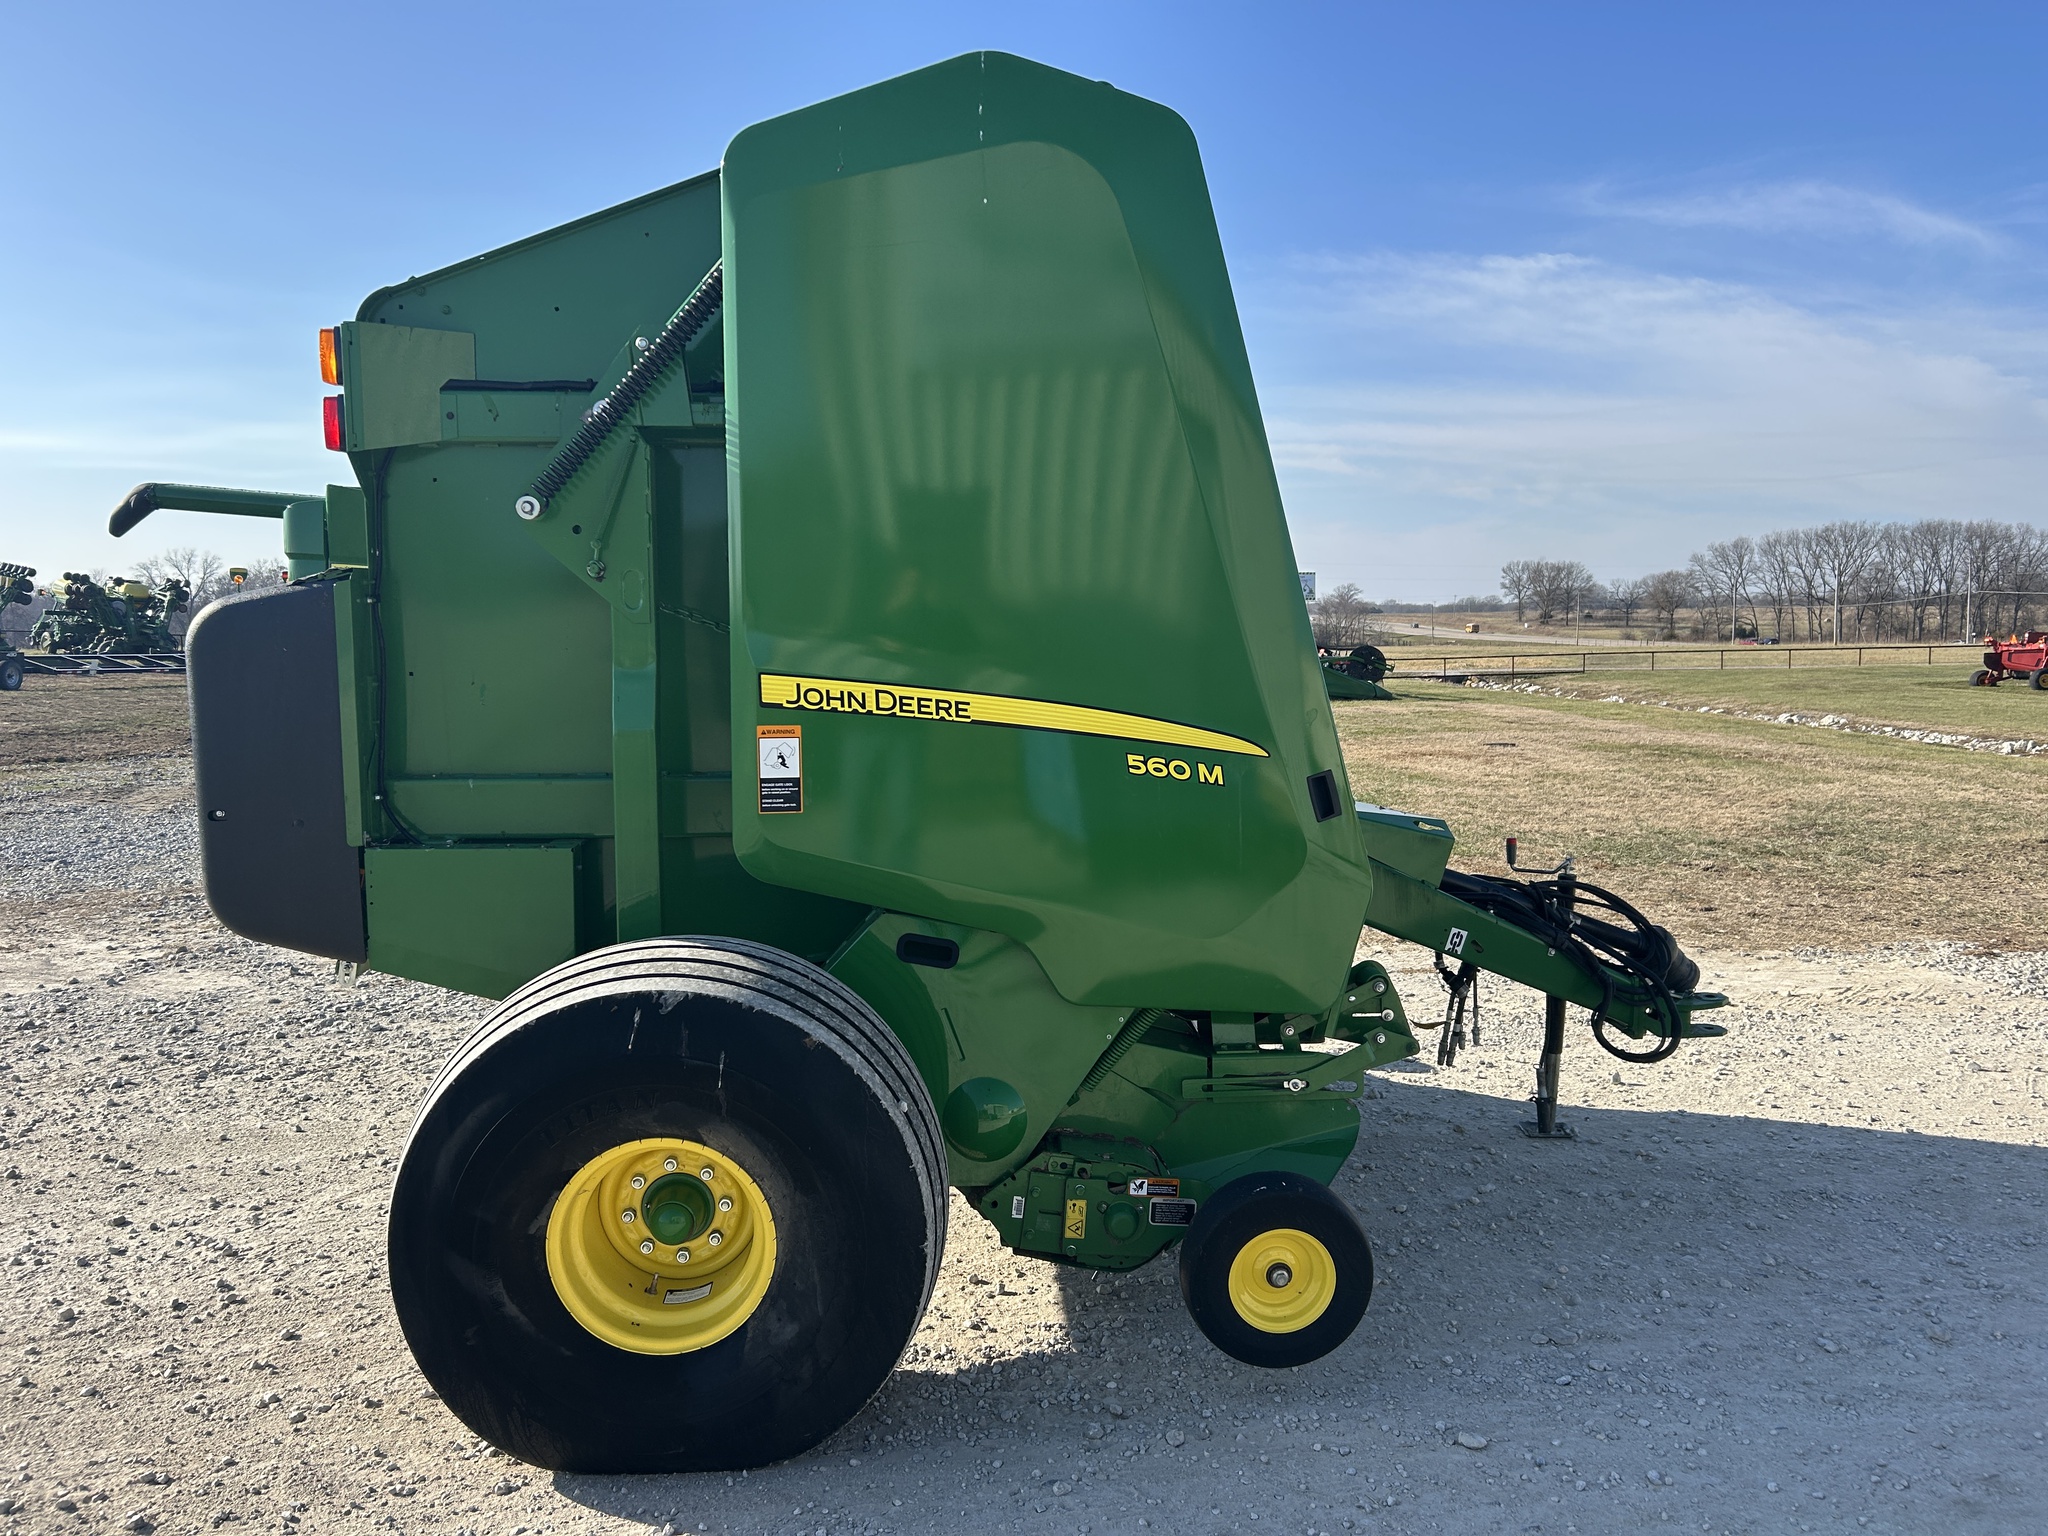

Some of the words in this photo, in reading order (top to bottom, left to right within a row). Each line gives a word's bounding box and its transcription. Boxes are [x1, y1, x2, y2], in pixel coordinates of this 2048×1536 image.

[785, 682, 866, 710] JOHN
[874, 689, 972, 720] DEERE
[1126, 753, 1192, 780] 560
[1197, 762, 1225, 786] M
[536, 1089, 660, 1151] TITAN
